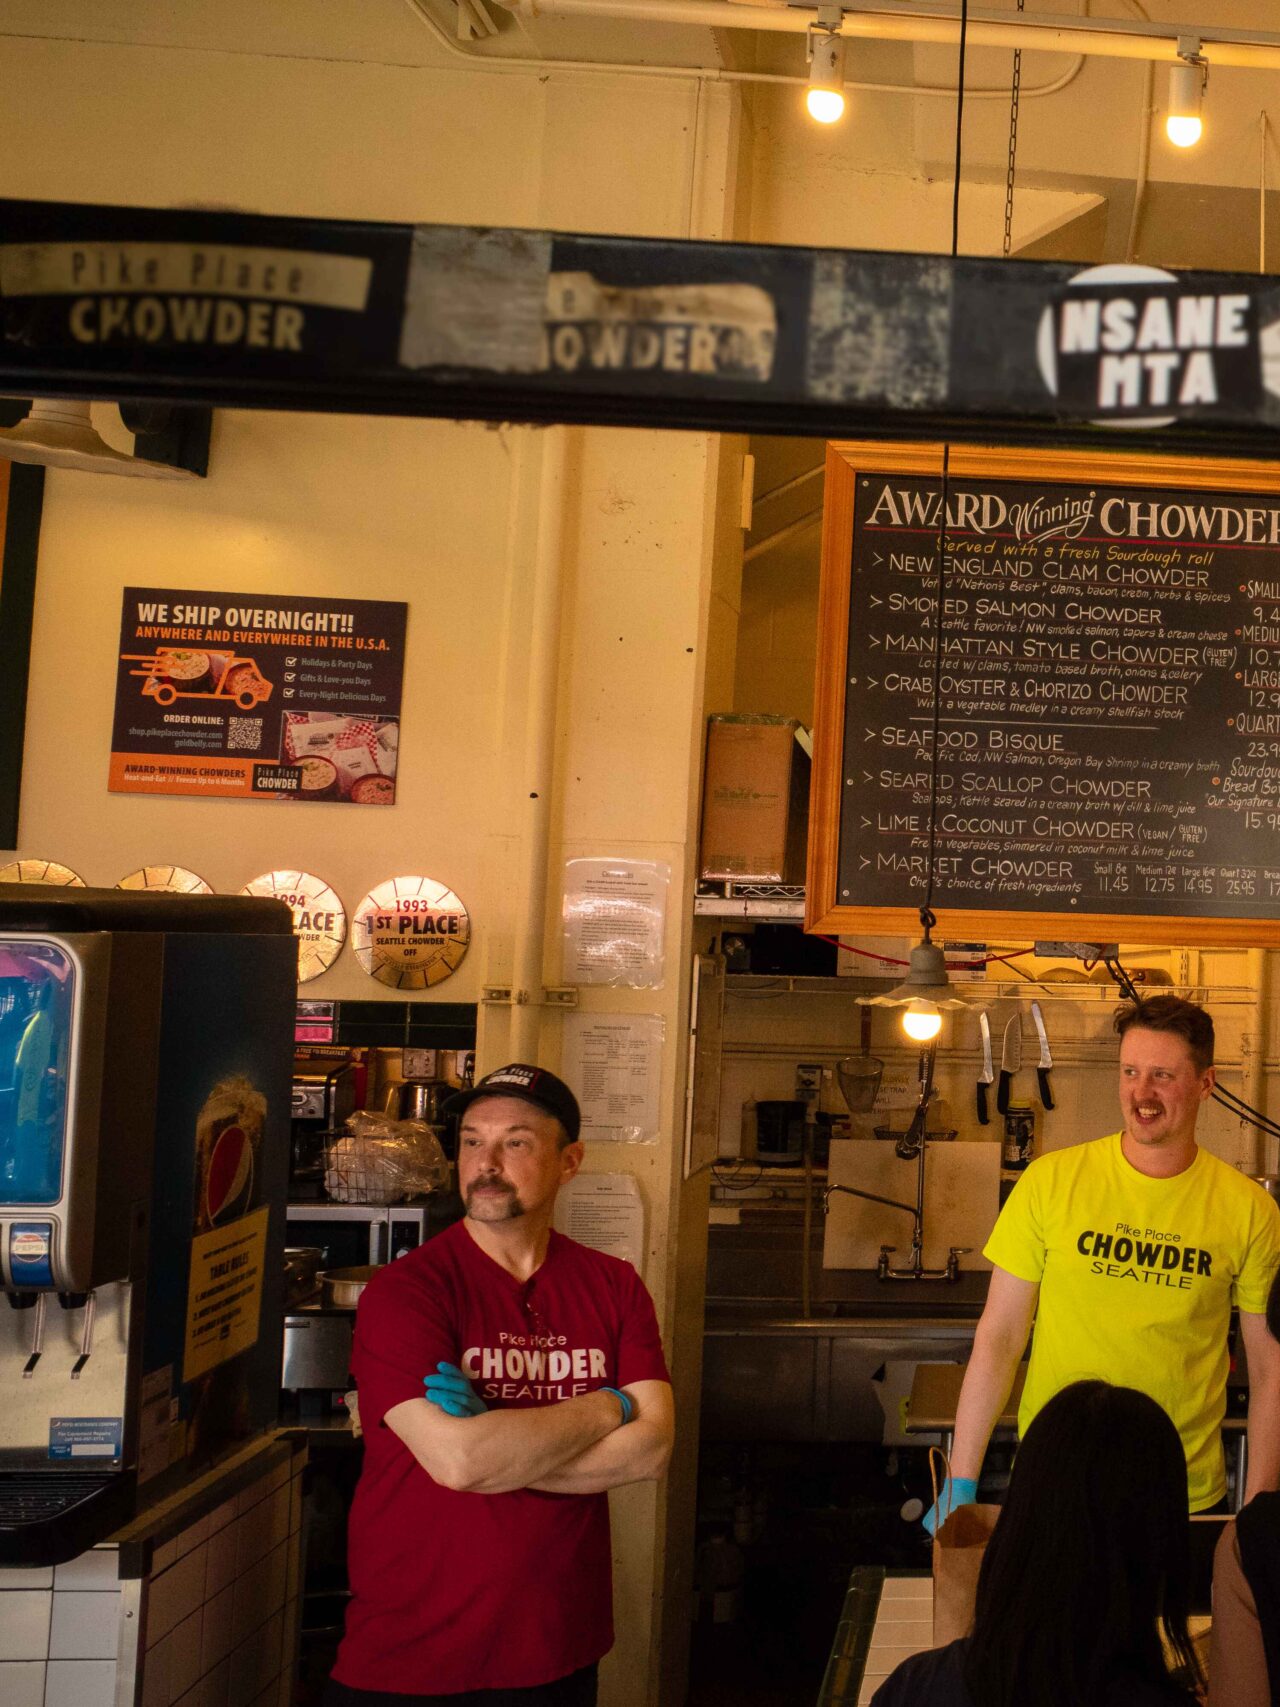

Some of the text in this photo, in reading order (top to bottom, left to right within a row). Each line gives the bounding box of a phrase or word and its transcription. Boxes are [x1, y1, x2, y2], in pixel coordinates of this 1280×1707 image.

[72, 251, 302, 295] Pike Place
[70, 299, 304, 350] CHOWDER
[541, 324, 716, 374] OWDER
[1099, 352, 1217, 408] MTA
[865, 484, 1006, 534] AWARD
[1009, 496, 1094, 541] Winning
[937, 535, 1214, 568] Served with a fresh Sourdough roll
[890, 553, 1209, 587] NEW ENGLAND CLAM CHOWDER
[1247, 580, 1280, 599] SMALL
[138, 603, 354, 633] WE SHIP OVERNIGHT!!
[889, 593, 1162, 624] SMOKED SALMON CHOWDER
[135, 626, 390, 651] ANYWHERE AND EVERYWHERE IN THE U.S.A.
[885, 634, 1199, 666] MANHATTAN STYLE CHOWDER
[301, 657, 373, 670] Holidays Party Days
[300, 673, 371, 686] Gifts Love-you Days
[884, 673, 1187, 704] CRAB, OYSTER & CHORIZO CHOWDER
[299, 689, 387, 704] Every-Night Delicious Days
[163, 715, 224, 725] ORDER ONLINE:
[882, 727, 1064, 751] SEAFOOD BISQUE
[125, 764, 246, 778] AWARD-WINNING CHOWDERS
[257, 777, 298, 790] CHOWDER
[880, 770, 1151, 797] SEARED SCALLOP CHOWDER
[1222, 778, 1257, 794] Bread
[1228, 794, 1273, 811] Signature
[878, 813, 1134, 839] LIME COCONUT CHOWDER
[877, 852, 1073, 878] MARKET CHOWDER
[1099, 877, 1129, 893] 11.45
[1145, 878, 1175, 893] 12.75
[1184, 879, 1213, 894] 14.95
[1226, 880, 1255, 896] 25.95
[273, 894, 306, 908] 994
[395, 900, 428, 913] 1993
[292, 911, 335, 932] ACE
[366, 915, 458, 935] 1ST PLACE
[376, 937, 406, 945] SEATTLE
[1115, 1223, 1182, 1243] Pike Place
[1077, 1230, 1212, 1277] CHOWDER
[1090, 1261, 1193, 1290] SEATTLE
[499, 1332, 526, 1346] Pike
[461, 1347, 607, 1381] CHOWDER
[483, 1383, 587, 1400] SEATTLE
